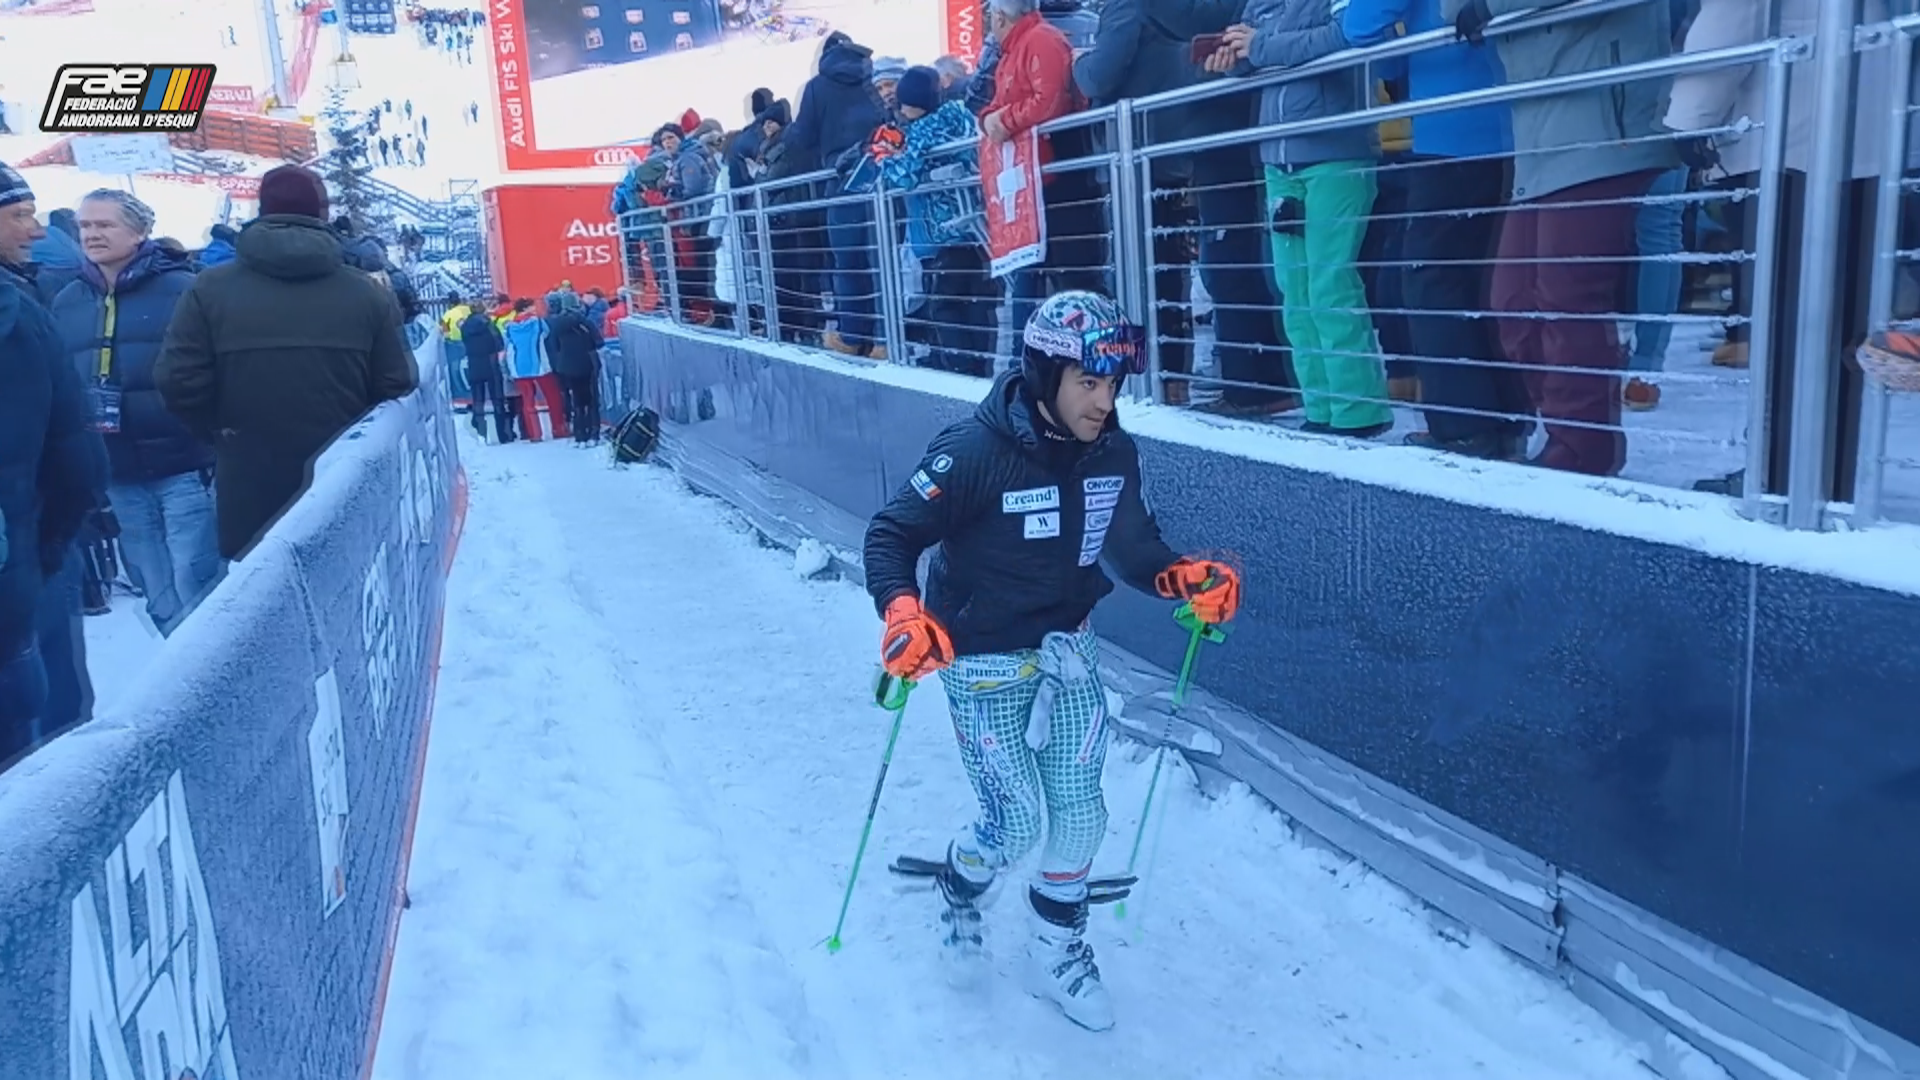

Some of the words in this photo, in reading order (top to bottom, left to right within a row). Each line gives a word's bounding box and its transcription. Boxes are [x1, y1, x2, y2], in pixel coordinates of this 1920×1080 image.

[499, 23, 516, 53] Ski
[502, 60, 521, 94] FIS
[506, 98, 526, 147] Audi
[567, 244, 612, 265] FIS
[1032, 333, 1072, 349] HEAD
[1004, 489, 1052, 507] Creand
[966, 739, 1012, 808] ONYONE
